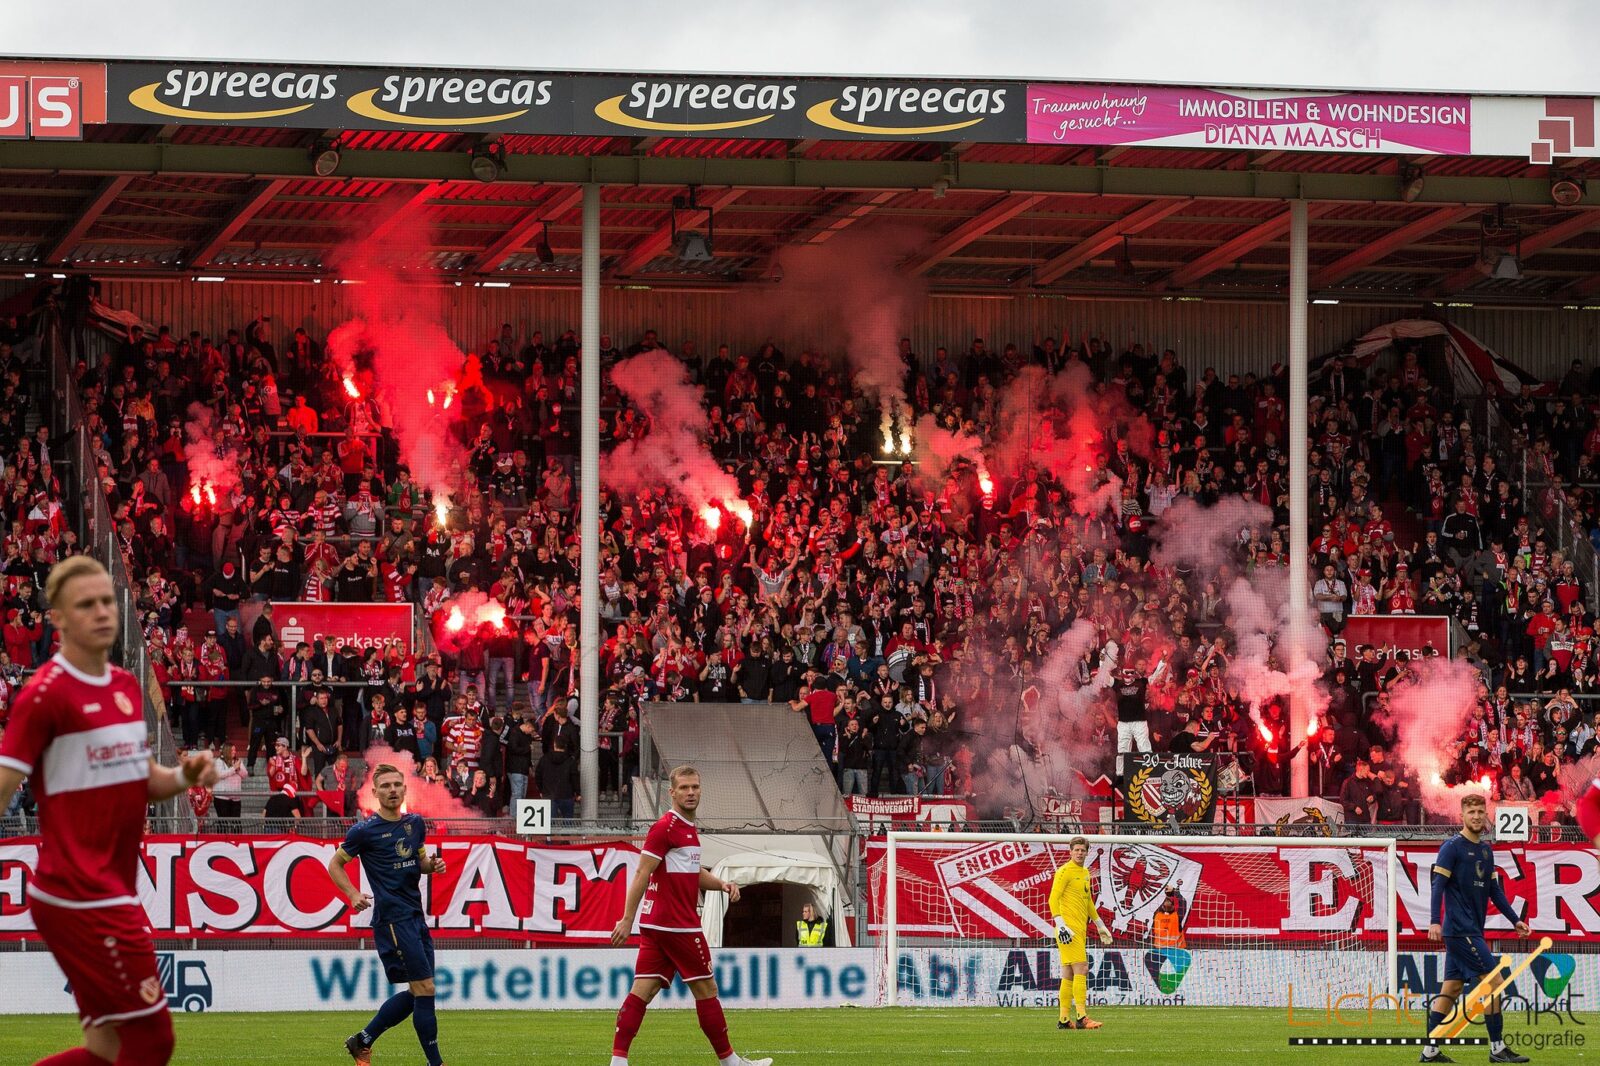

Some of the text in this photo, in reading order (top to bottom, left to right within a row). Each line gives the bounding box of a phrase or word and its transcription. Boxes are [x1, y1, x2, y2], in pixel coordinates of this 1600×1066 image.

[1032, 93, 1148, 116] Traumwohnung
[1179, 98, 1467, 125] IMMOBILIEN & WOHNDESIGN
[1205, 123, 1382, 148] DIANA MAASCH
[1142, 753, 1203, 771] 20 Jahre
[522, 805, 546, 828] 21
[852, 804, 913, 813] STADIONVERBOT
[1499, 813, 1524, 834] 22
[955, 841, 1032, 879] ENERGIE
[1013, 869, 1052, 892] COTTBUS
